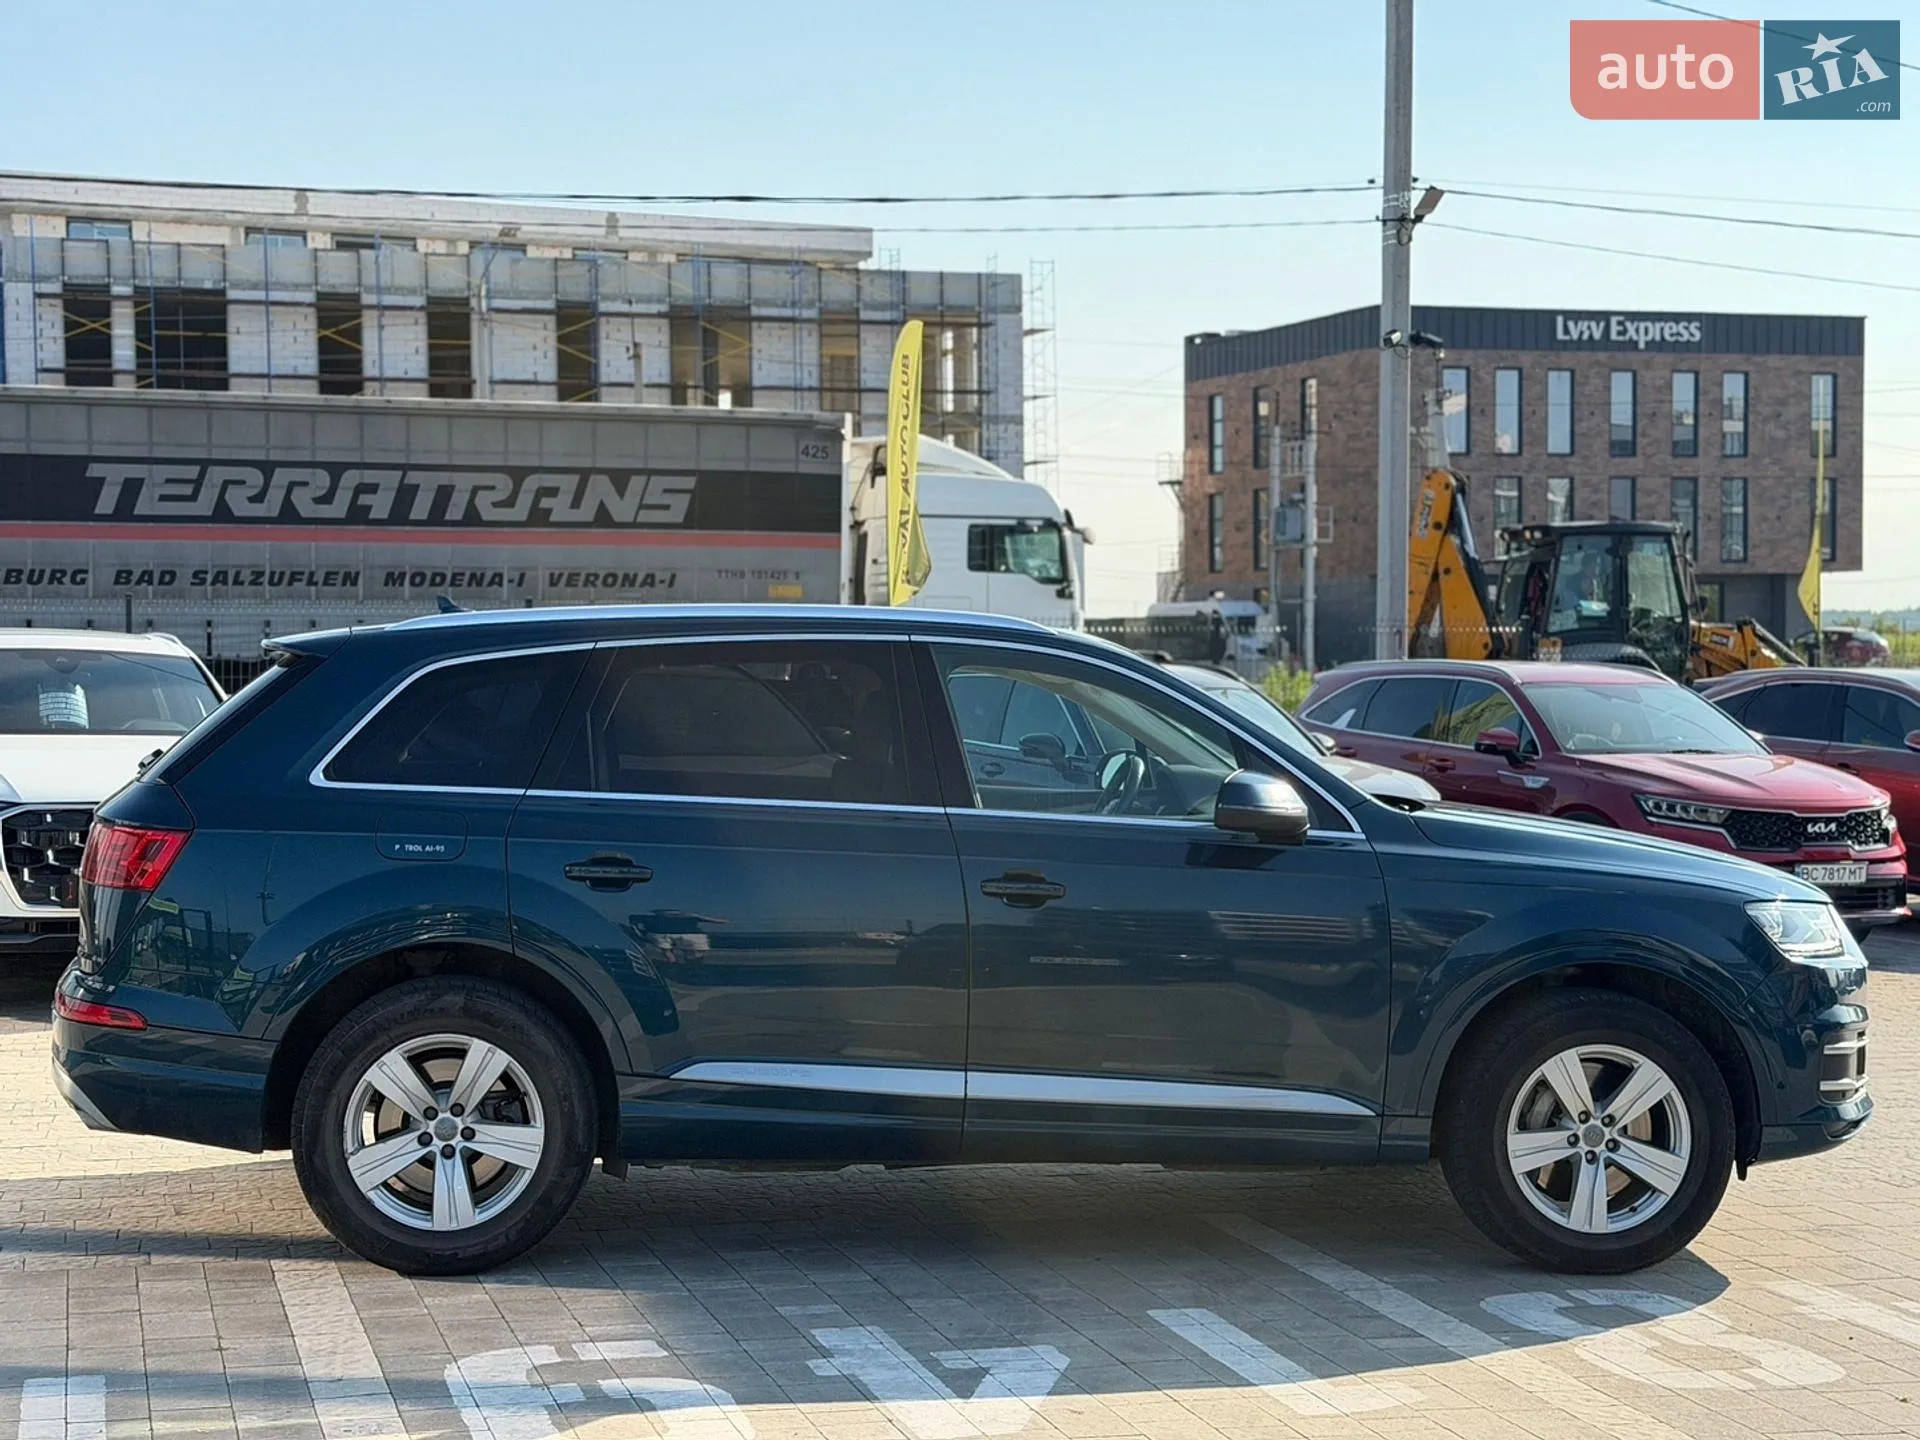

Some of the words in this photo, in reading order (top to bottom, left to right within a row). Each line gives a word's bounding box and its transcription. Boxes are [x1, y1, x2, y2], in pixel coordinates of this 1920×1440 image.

[1609, 315, 1702, 350] Express
[800, 444, 829, 460] 425
[85, 462, 698, 524] TERRATRANS
[0, 567, 89, 587] BURG
[112, 568, 178, 587] BAD
[189, 569, 361, 588] SALZUFLEN
[383, 569, 526, 589] MODENA-I
[547, 570, 678, 589] VERONA-I
[1806, 821, 1837, 834] KIA
